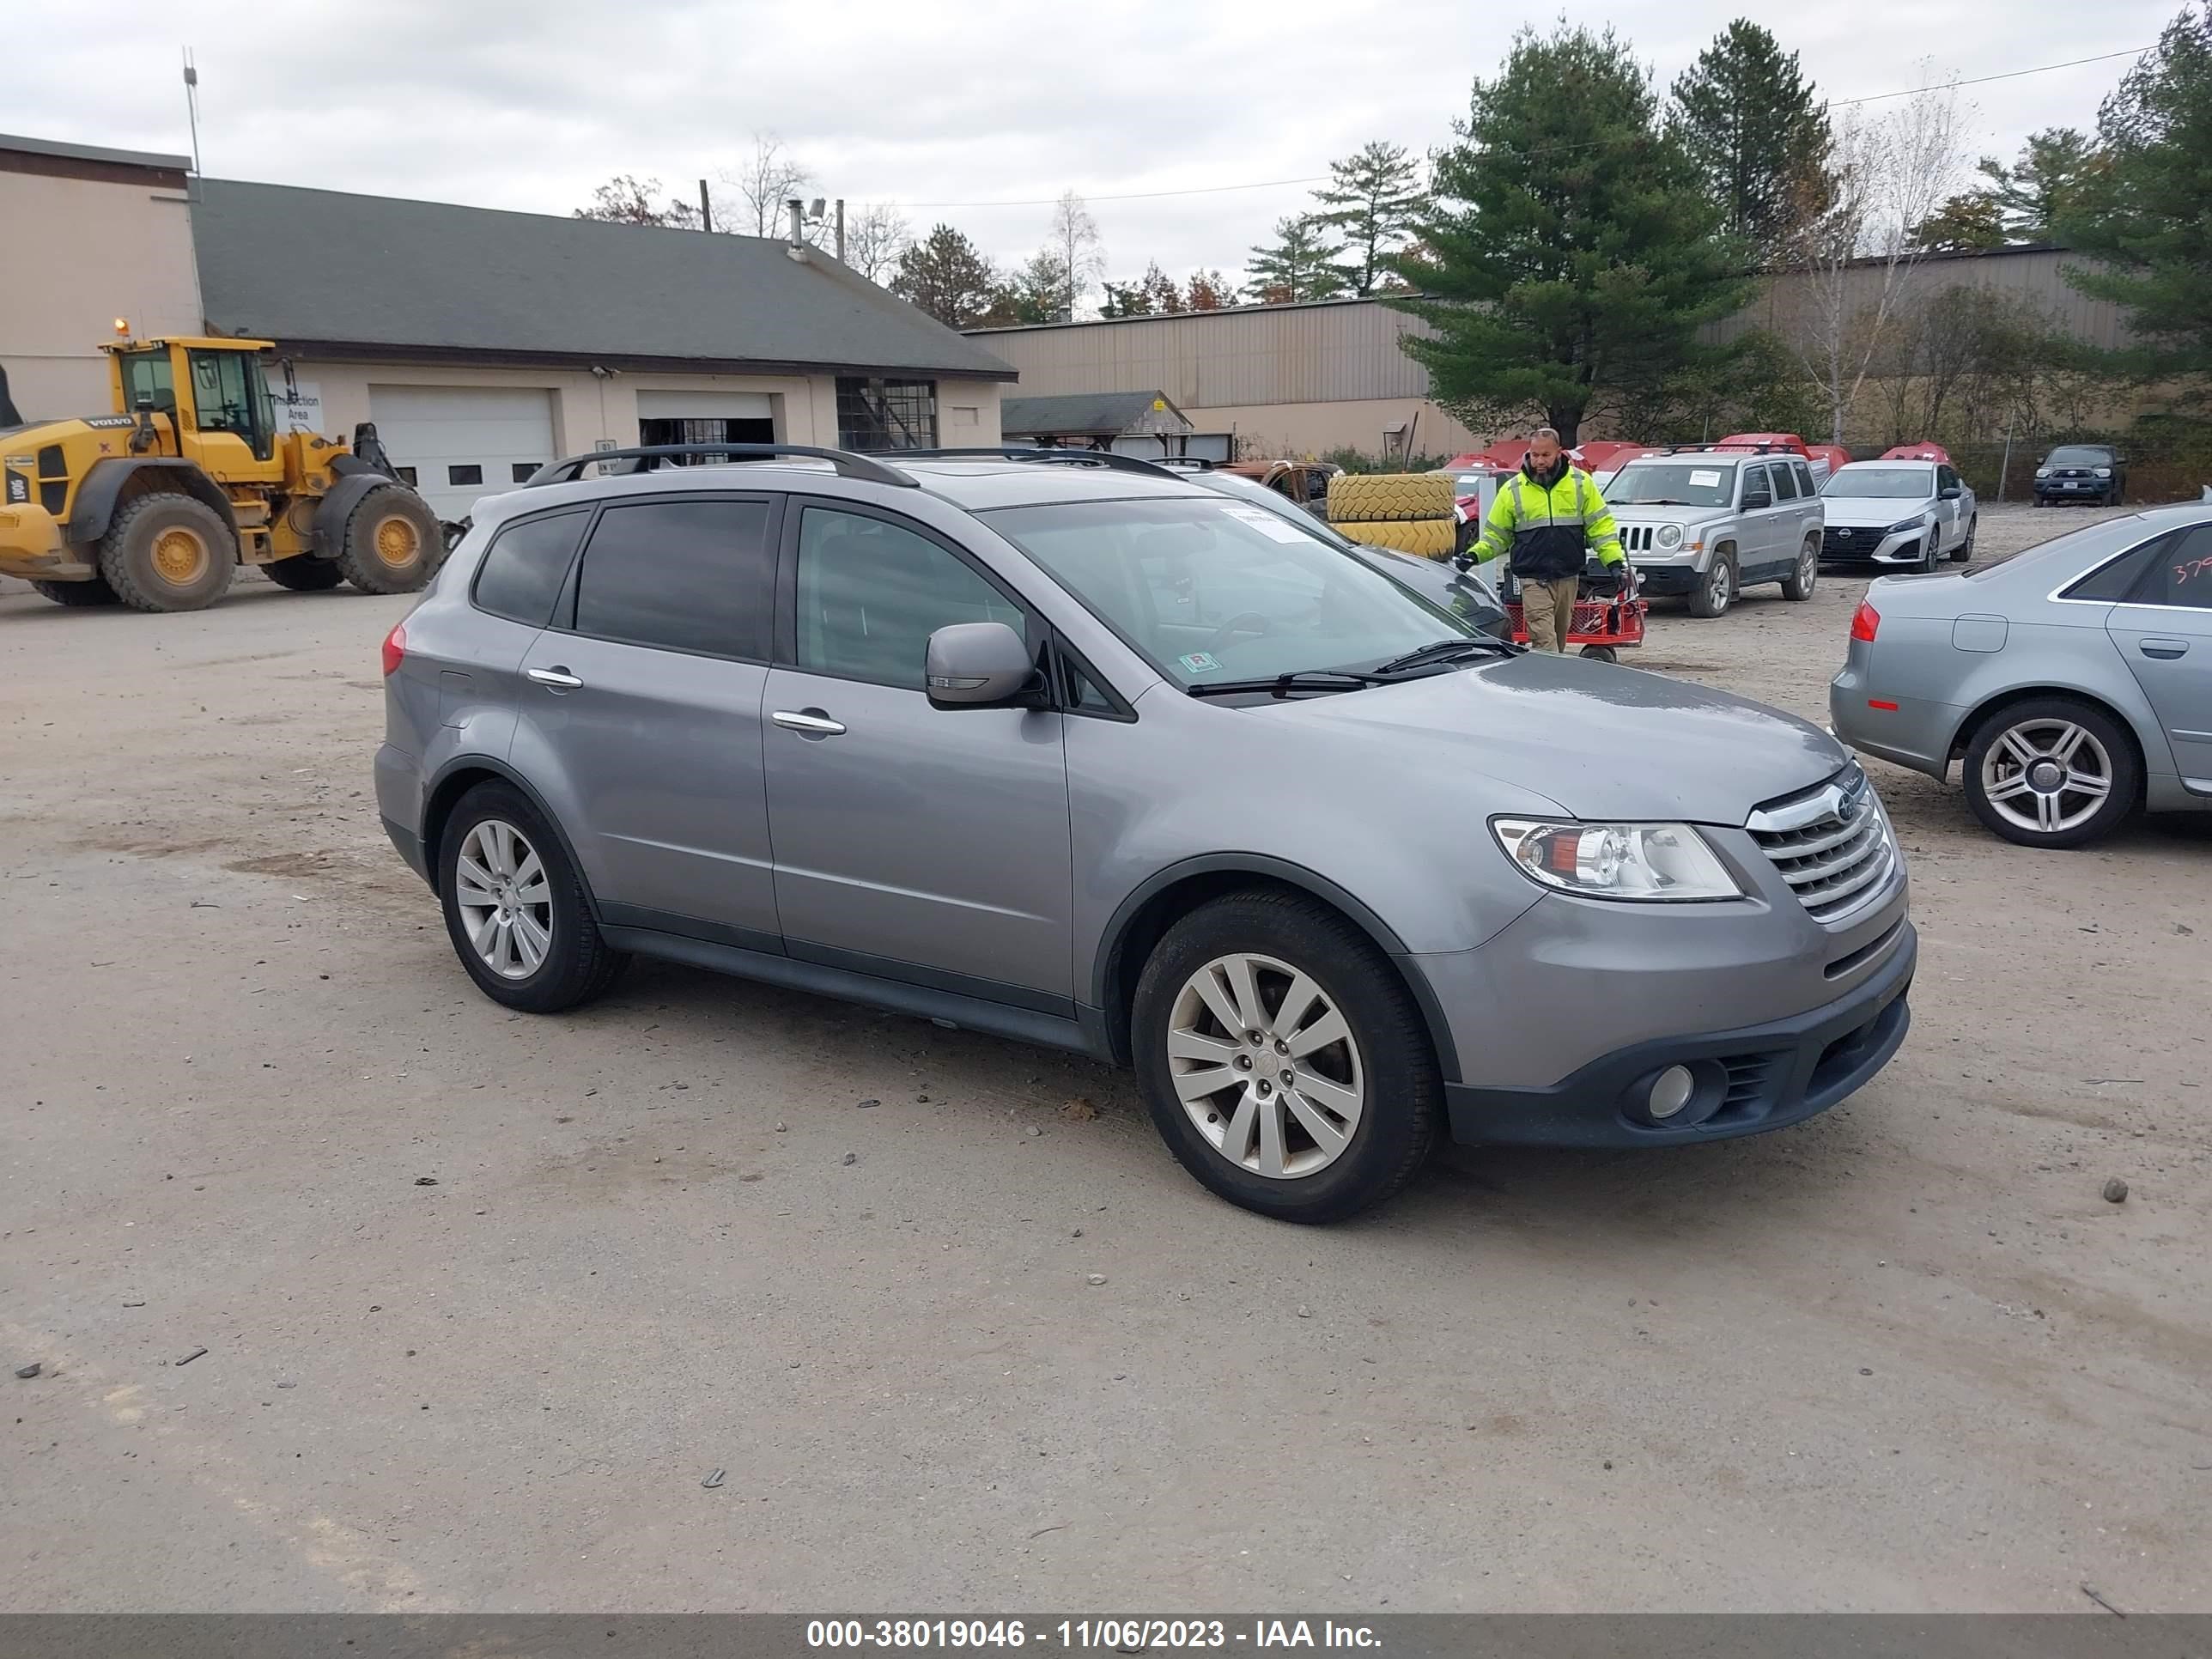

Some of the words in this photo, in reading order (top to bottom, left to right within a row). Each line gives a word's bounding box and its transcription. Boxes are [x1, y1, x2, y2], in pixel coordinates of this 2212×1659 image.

[275, 396, 319, 406] Insction
[289, 408, 308, 420] Area
[89, 417, 132, 426] VOLVO
